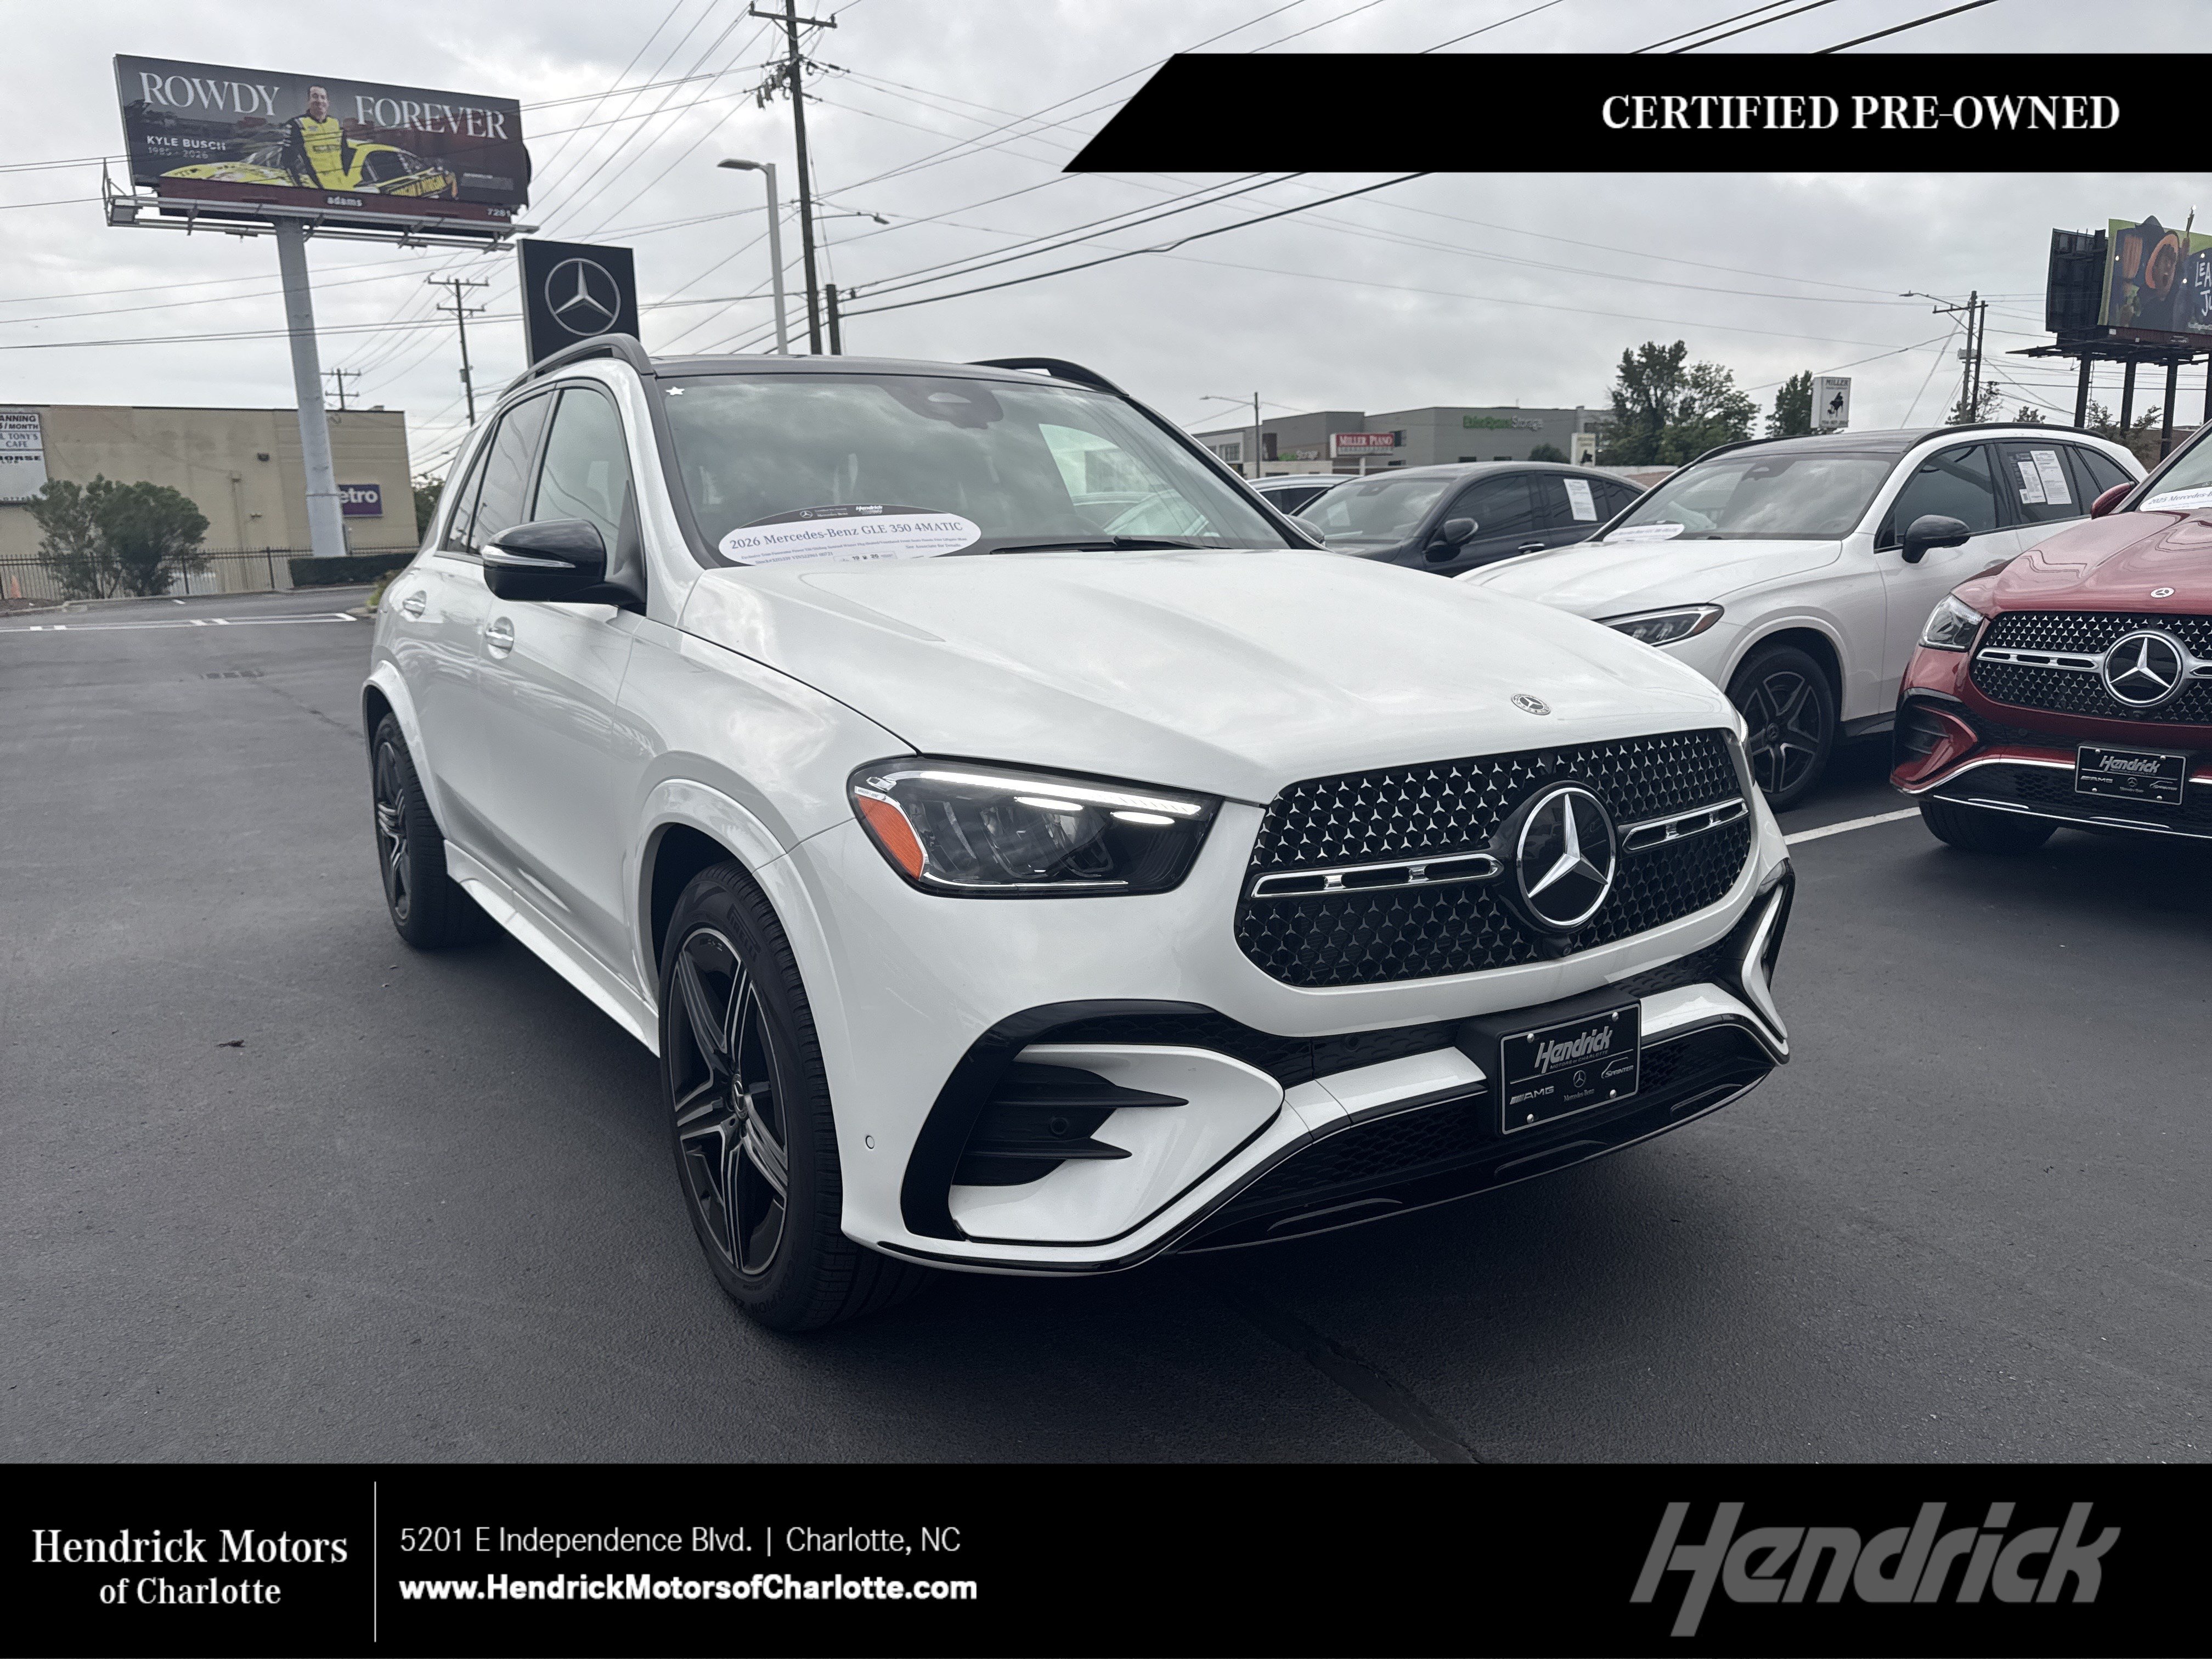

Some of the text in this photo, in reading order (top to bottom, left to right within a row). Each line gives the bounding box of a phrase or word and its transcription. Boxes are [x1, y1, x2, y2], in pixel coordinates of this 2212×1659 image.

[139, 72, 508, 139] ROWDY FOREVER
[146, 135, 227, 151] KYLE BUSCH
[327, 196, 363, 207] adams
[339, 487, 379, 504] etro
[730, 537, 761, 549] 2026
[764, 528, 859, 545] Mercedes-Benz
[861, 524, 888, 535] GLE
[889, 523, 912, 533] 350
[915, 522, 963, 532] 4MATIC
[2099, 755, 2161, 774] Hendrick
[1534, 1026, 1613, 1074] Hendrick
[1523, 1086, 1555, 1101] AMG
